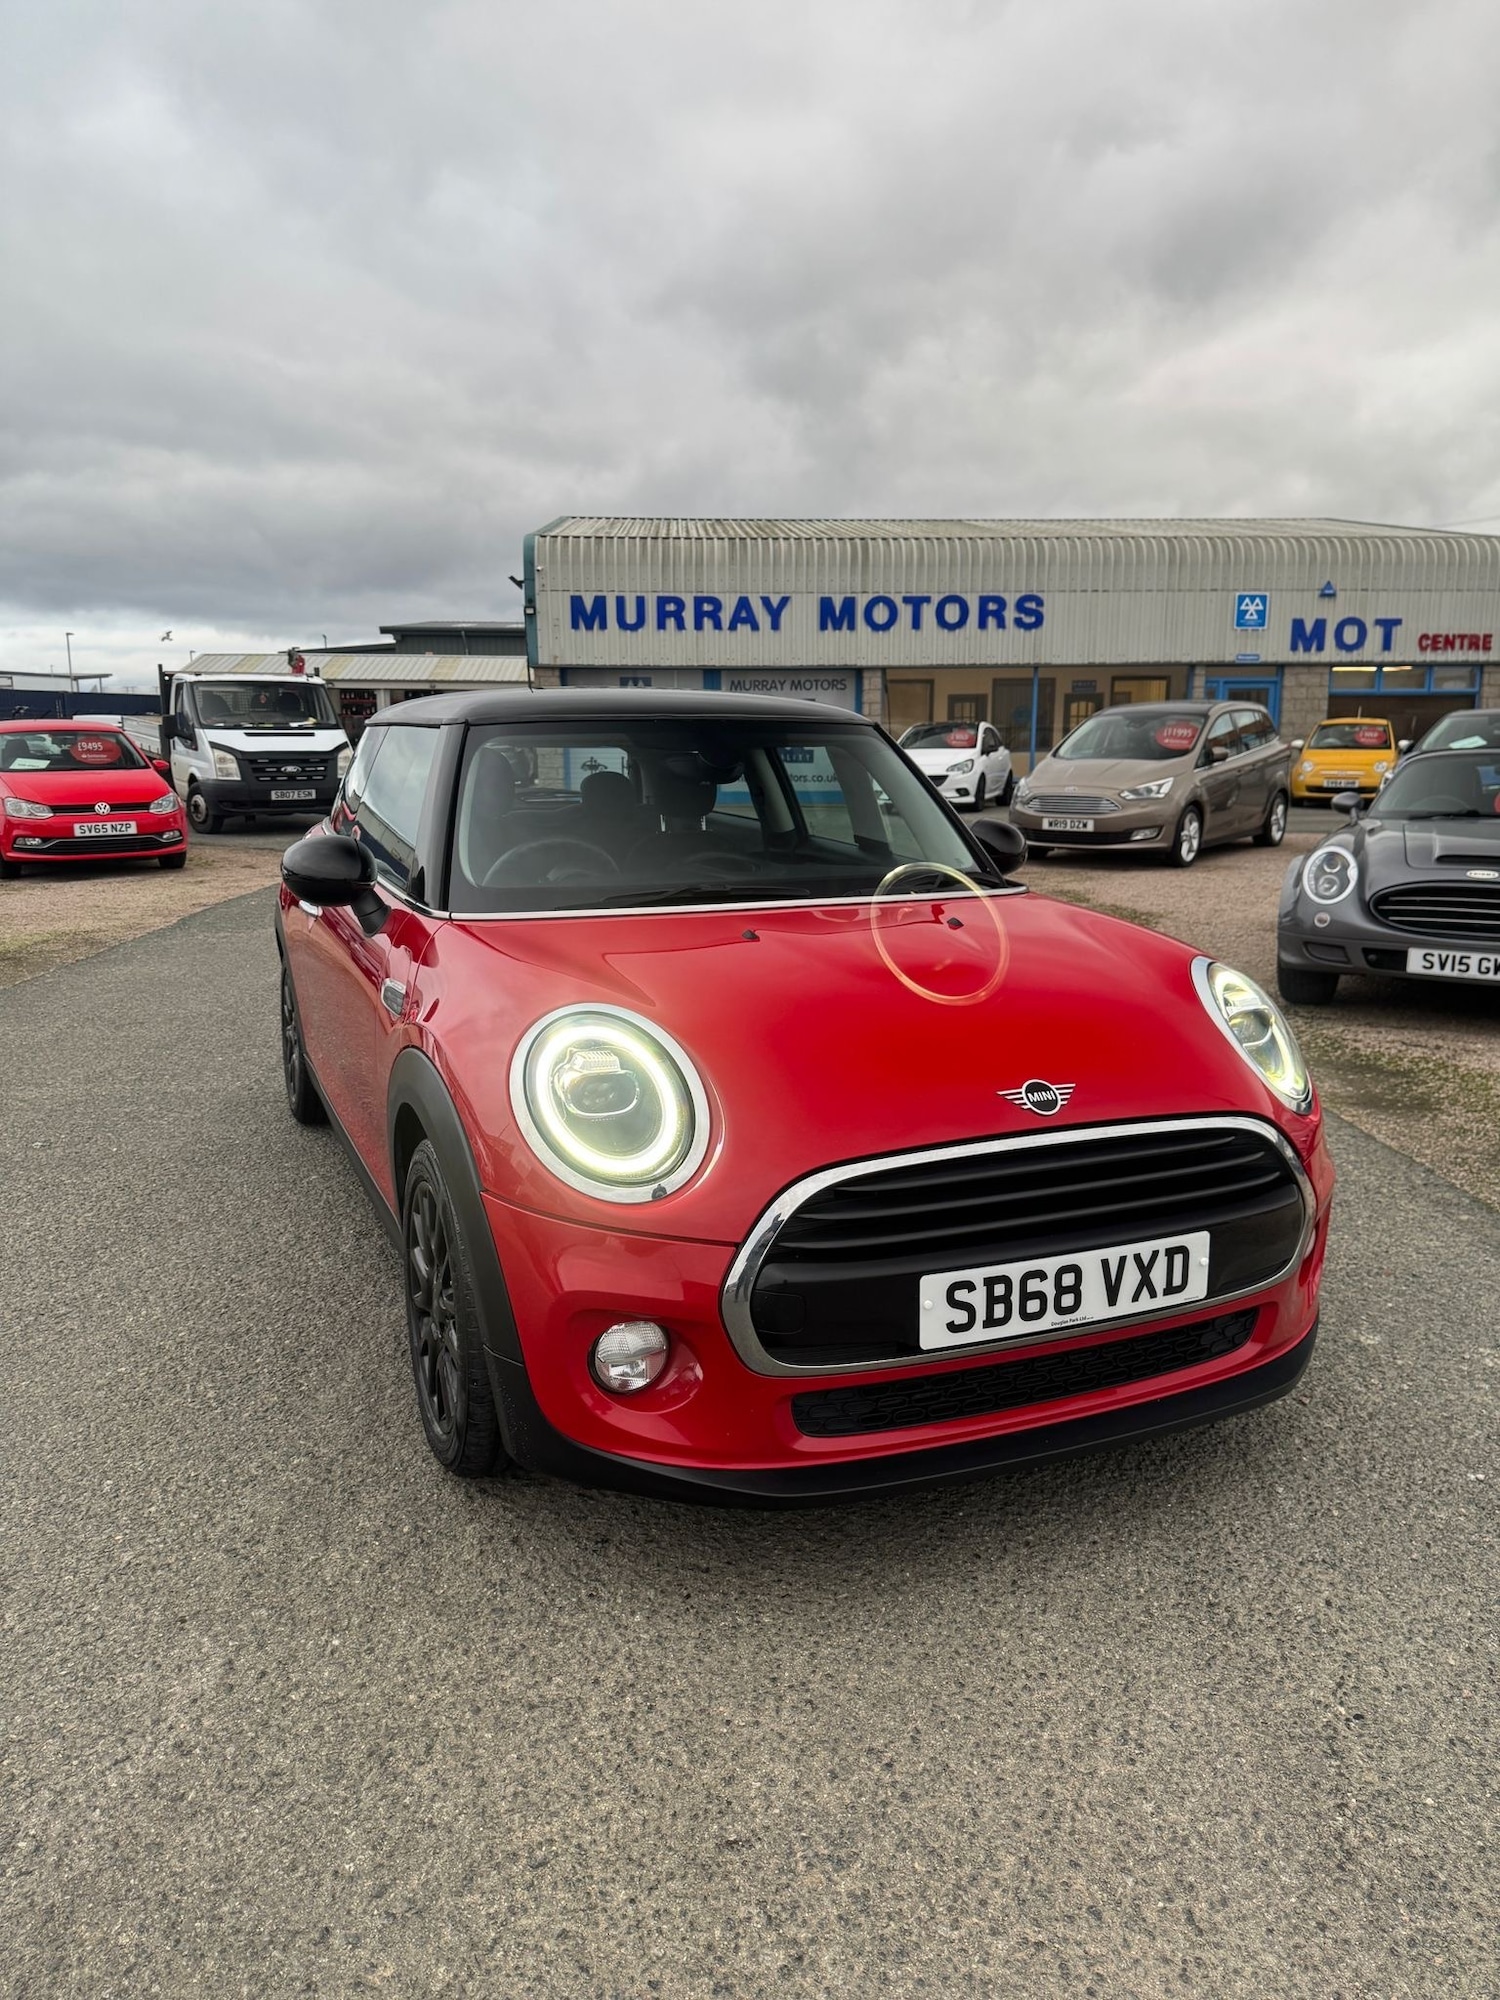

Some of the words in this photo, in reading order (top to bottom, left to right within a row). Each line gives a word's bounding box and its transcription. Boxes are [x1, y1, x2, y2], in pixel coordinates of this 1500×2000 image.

[571, 594, 791, 632] MURRAY
[820, 594, 1045, 632] MOTORS
[1289, 616, 1403, 653] MOT
[1418, 632, 1493, 652] CENTRE
[729, 679, 786, 691] MURRAY
[790, 678, 847, 691] MOTORS
[77, 741, 103, 751] £9495
[274, 791, 295, 799] SB07
[297, 790, 313, 798] ESN
[78, 824, 108, 835] SV65
[110, 822, 132, 833] NZP
[1048, 819, 1068, 829] WR19
[1070, 820, 1088, 829] DZW
[1422, 952, 1471, 973] SV15
[1027, 1090, 1056, 1102] MINI
[946, 1263, 1083, 1334] SB68
[1100, 1245, 1190, 1308] VXD
